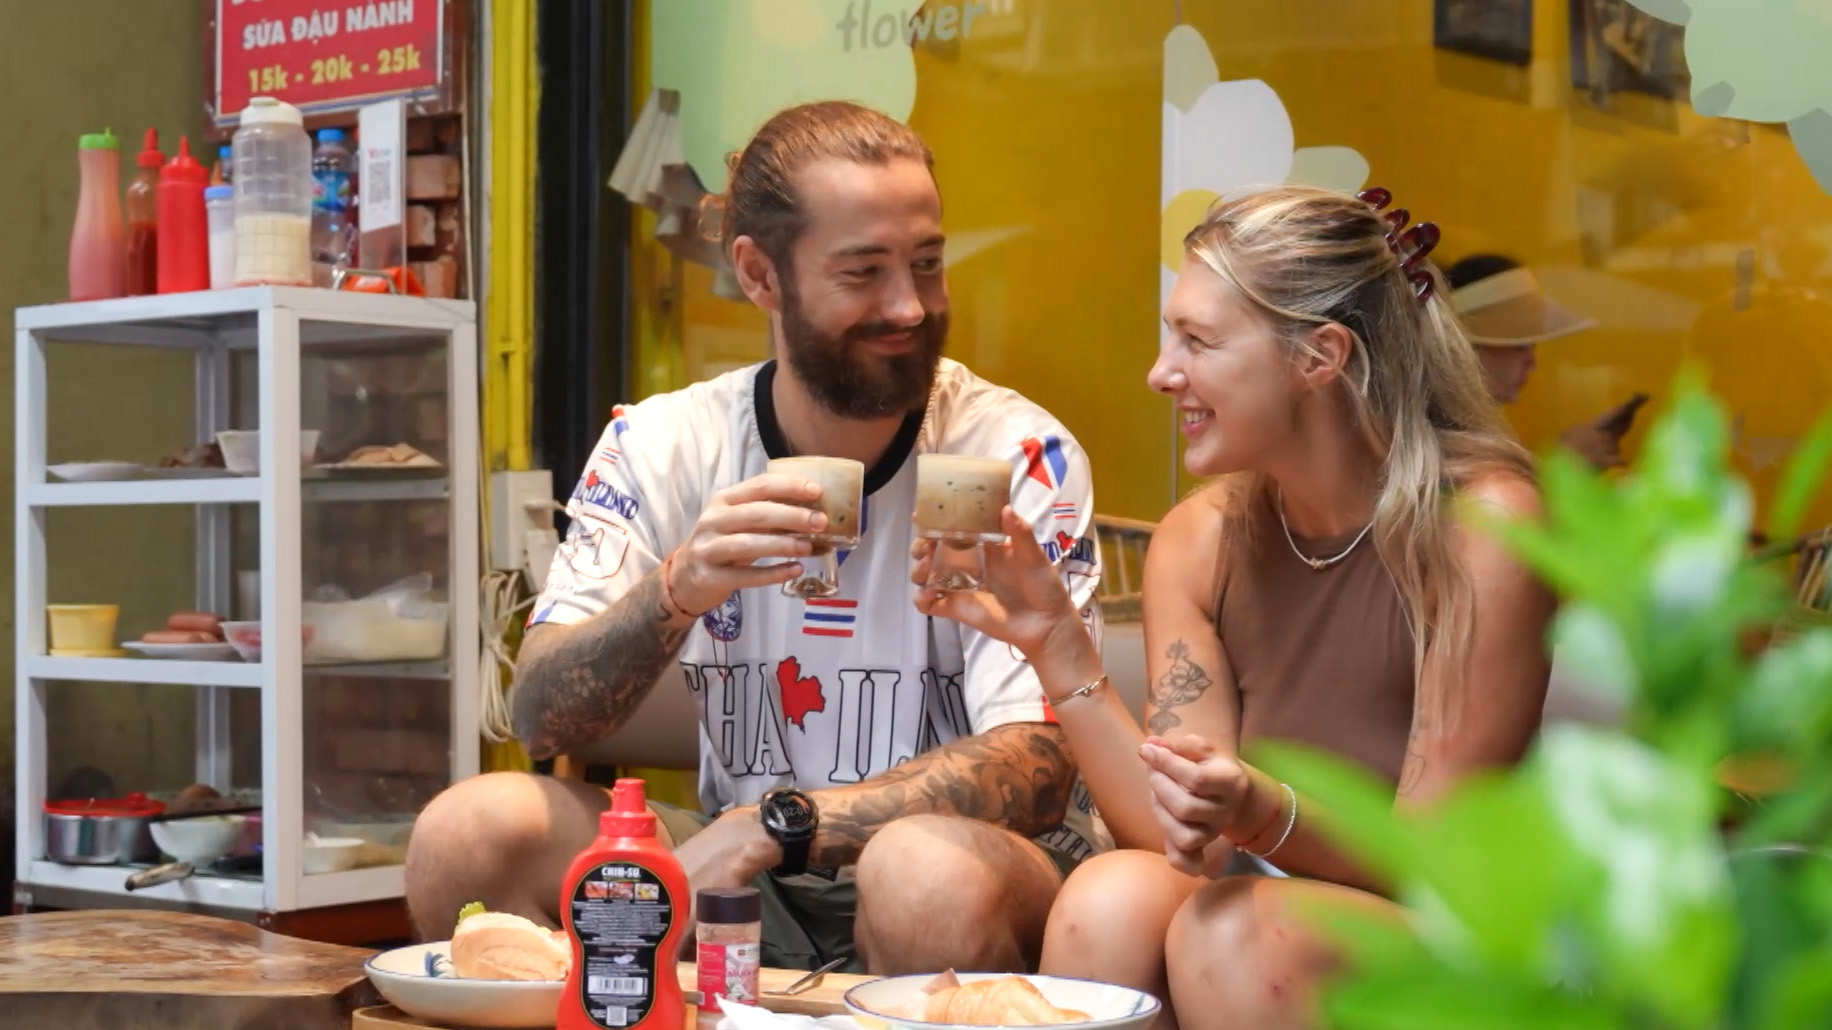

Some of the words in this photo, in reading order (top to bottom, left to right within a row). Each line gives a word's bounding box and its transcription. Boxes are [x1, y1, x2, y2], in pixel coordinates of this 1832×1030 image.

[836, 0, 988, 52] flower
[249, 65, 288, 93] 15k
[311, 55, 353, 85] 20k
[377, 43, 420, 75] 25k
